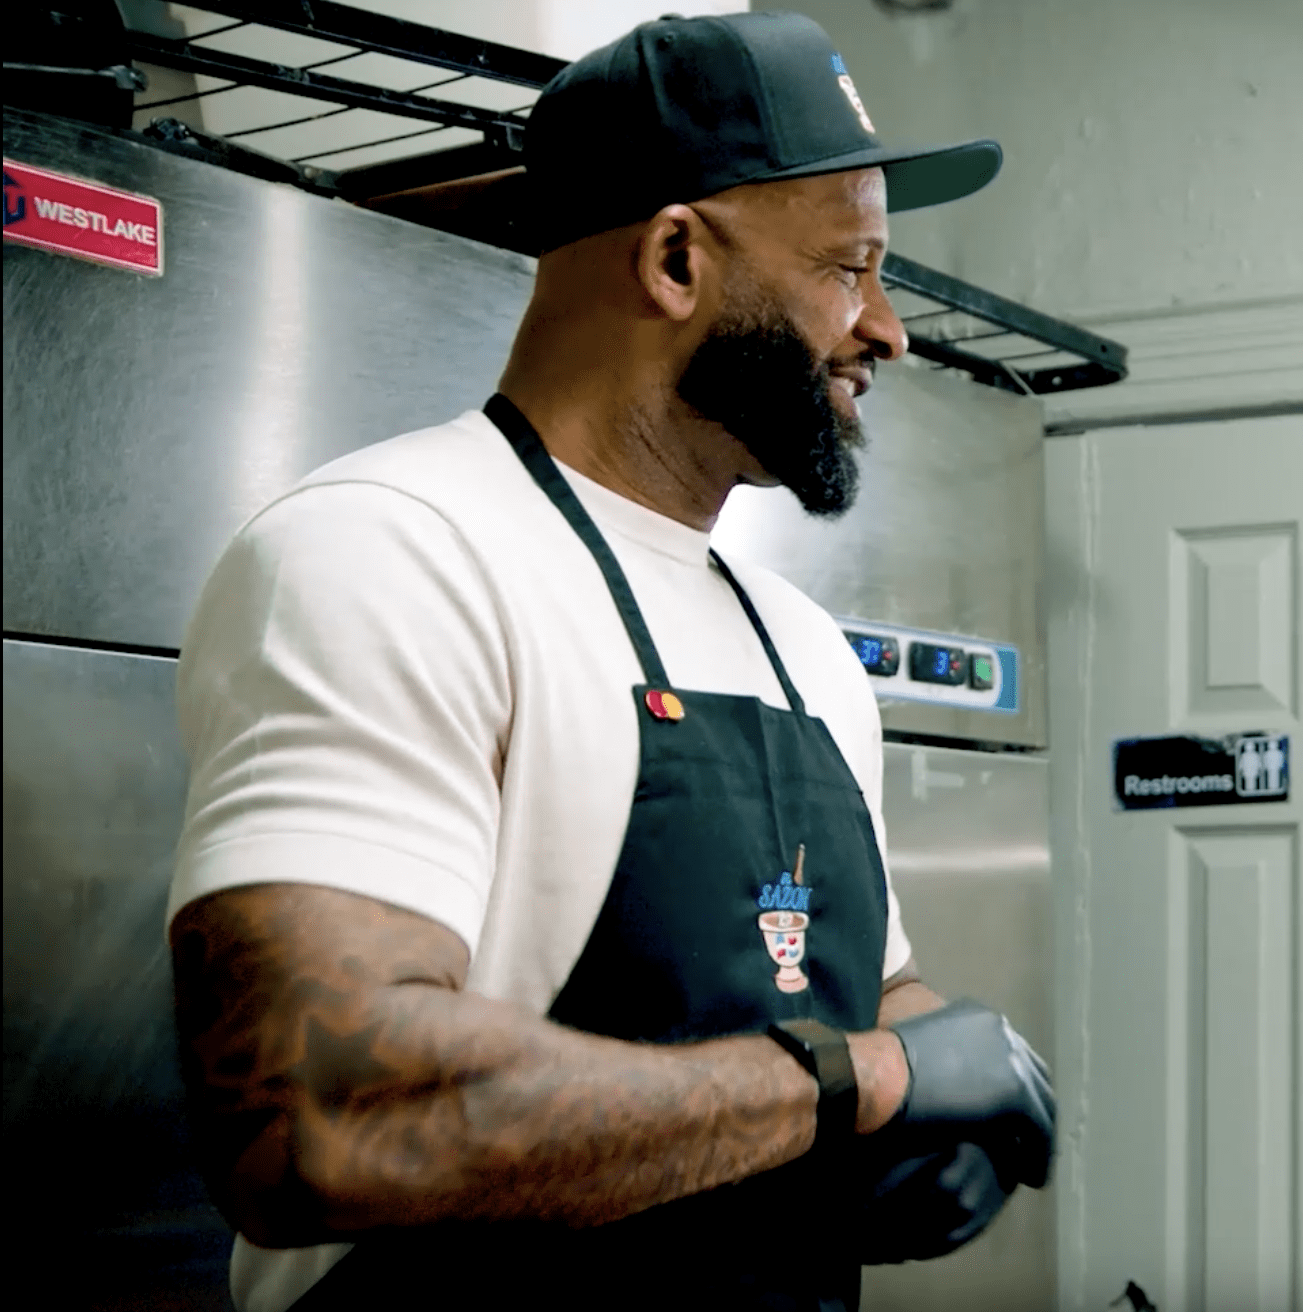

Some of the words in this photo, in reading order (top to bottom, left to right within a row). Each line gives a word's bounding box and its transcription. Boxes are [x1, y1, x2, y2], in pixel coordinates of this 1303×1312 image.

[34, 196, 157, 246] WESTLAKE
[1124, 774, 1234, 796] Restrooms
[758, 884, 813, 911] SAZON
